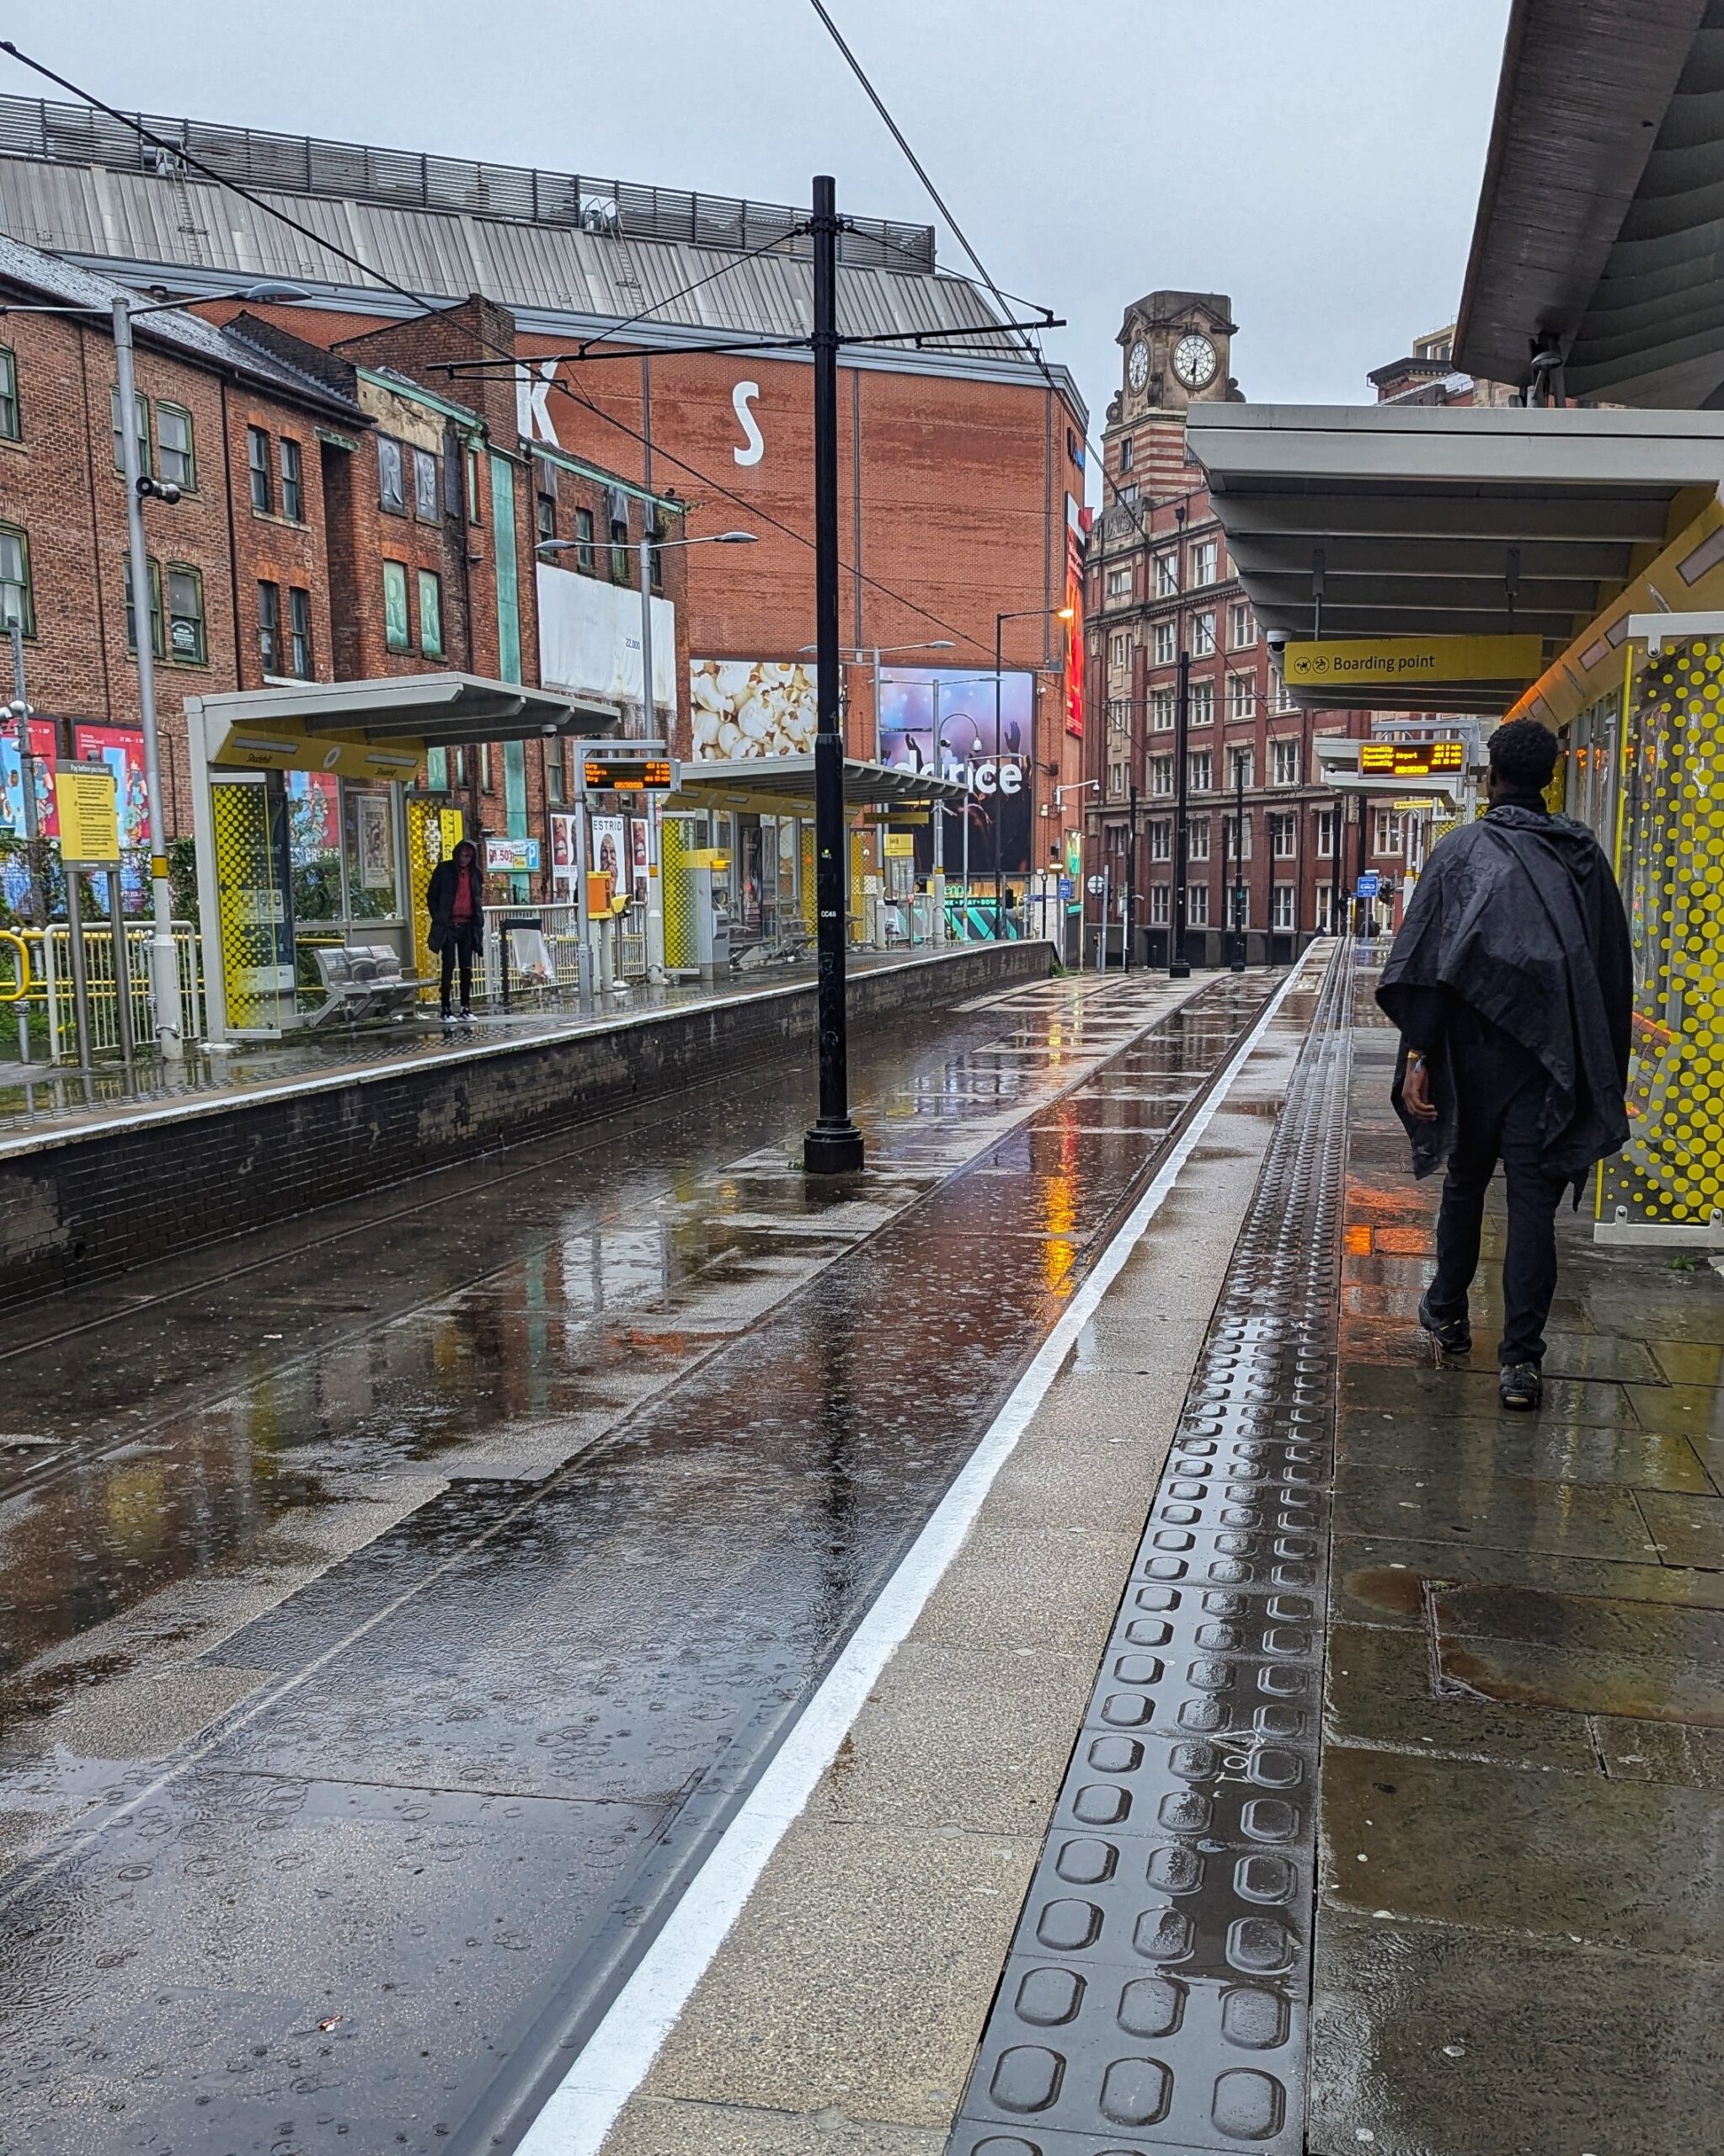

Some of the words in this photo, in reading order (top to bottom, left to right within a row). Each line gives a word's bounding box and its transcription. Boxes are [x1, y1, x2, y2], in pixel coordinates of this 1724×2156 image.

[515, 358, 560, 447] K
[732, 381, 765, 467] S
[1333, 656, 1395, 671] Boarding
[1398, 654, 1435, 671] point
[1363, 745, 1394, 754] Piccadilly
[1396, 752, 1417, 760] Airport
[593, 819, 622, 831] ESTRID
